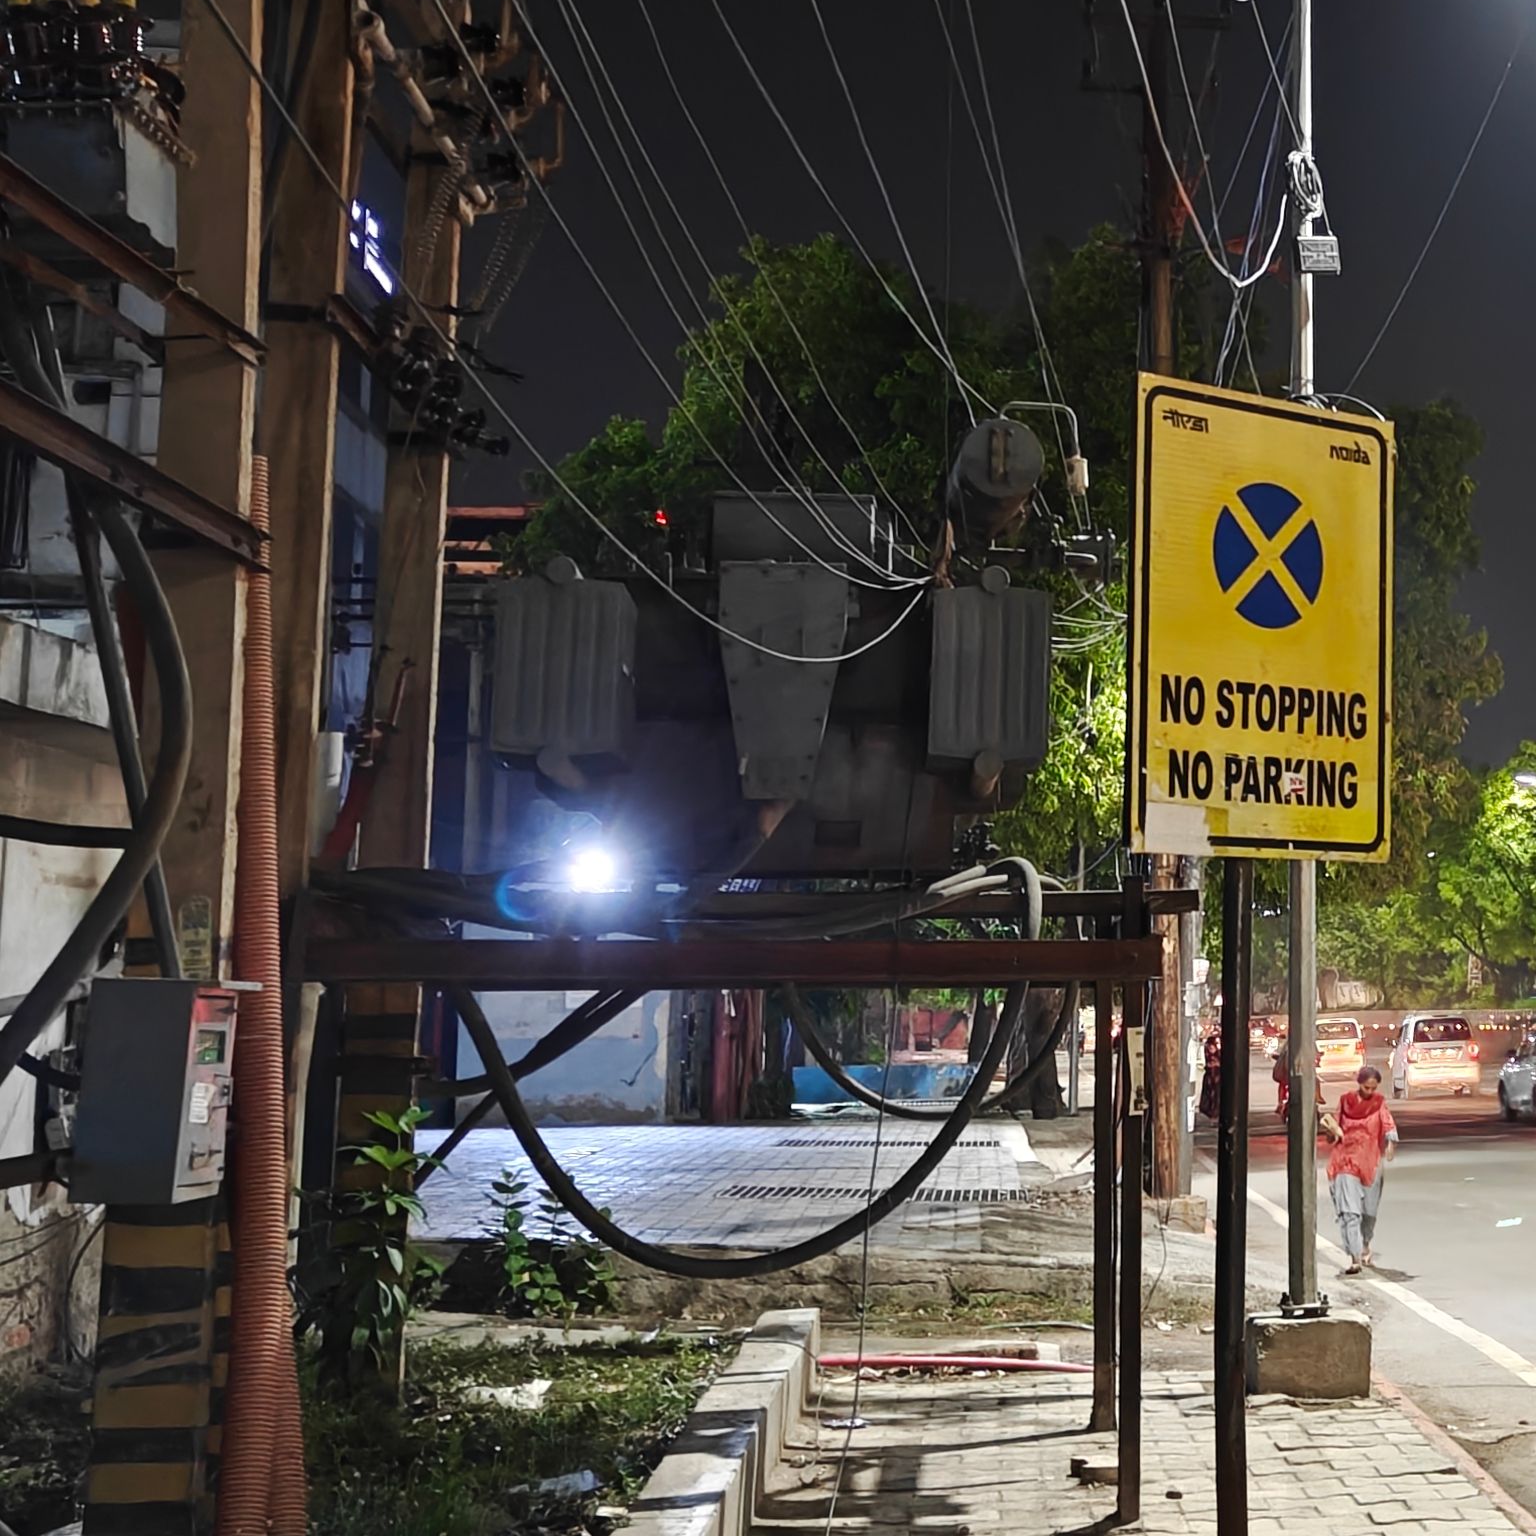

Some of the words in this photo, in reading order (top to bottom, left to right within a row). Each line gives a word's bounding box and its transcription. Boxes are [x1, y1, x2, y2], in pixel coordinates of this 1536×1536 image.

[1160, 674, 1205, 726] NO
[1216, 680, 1367, 739] STOPPING
[1168, 749, 1213, 801] NO
[1224, 754, 1358, 809] PARKING
